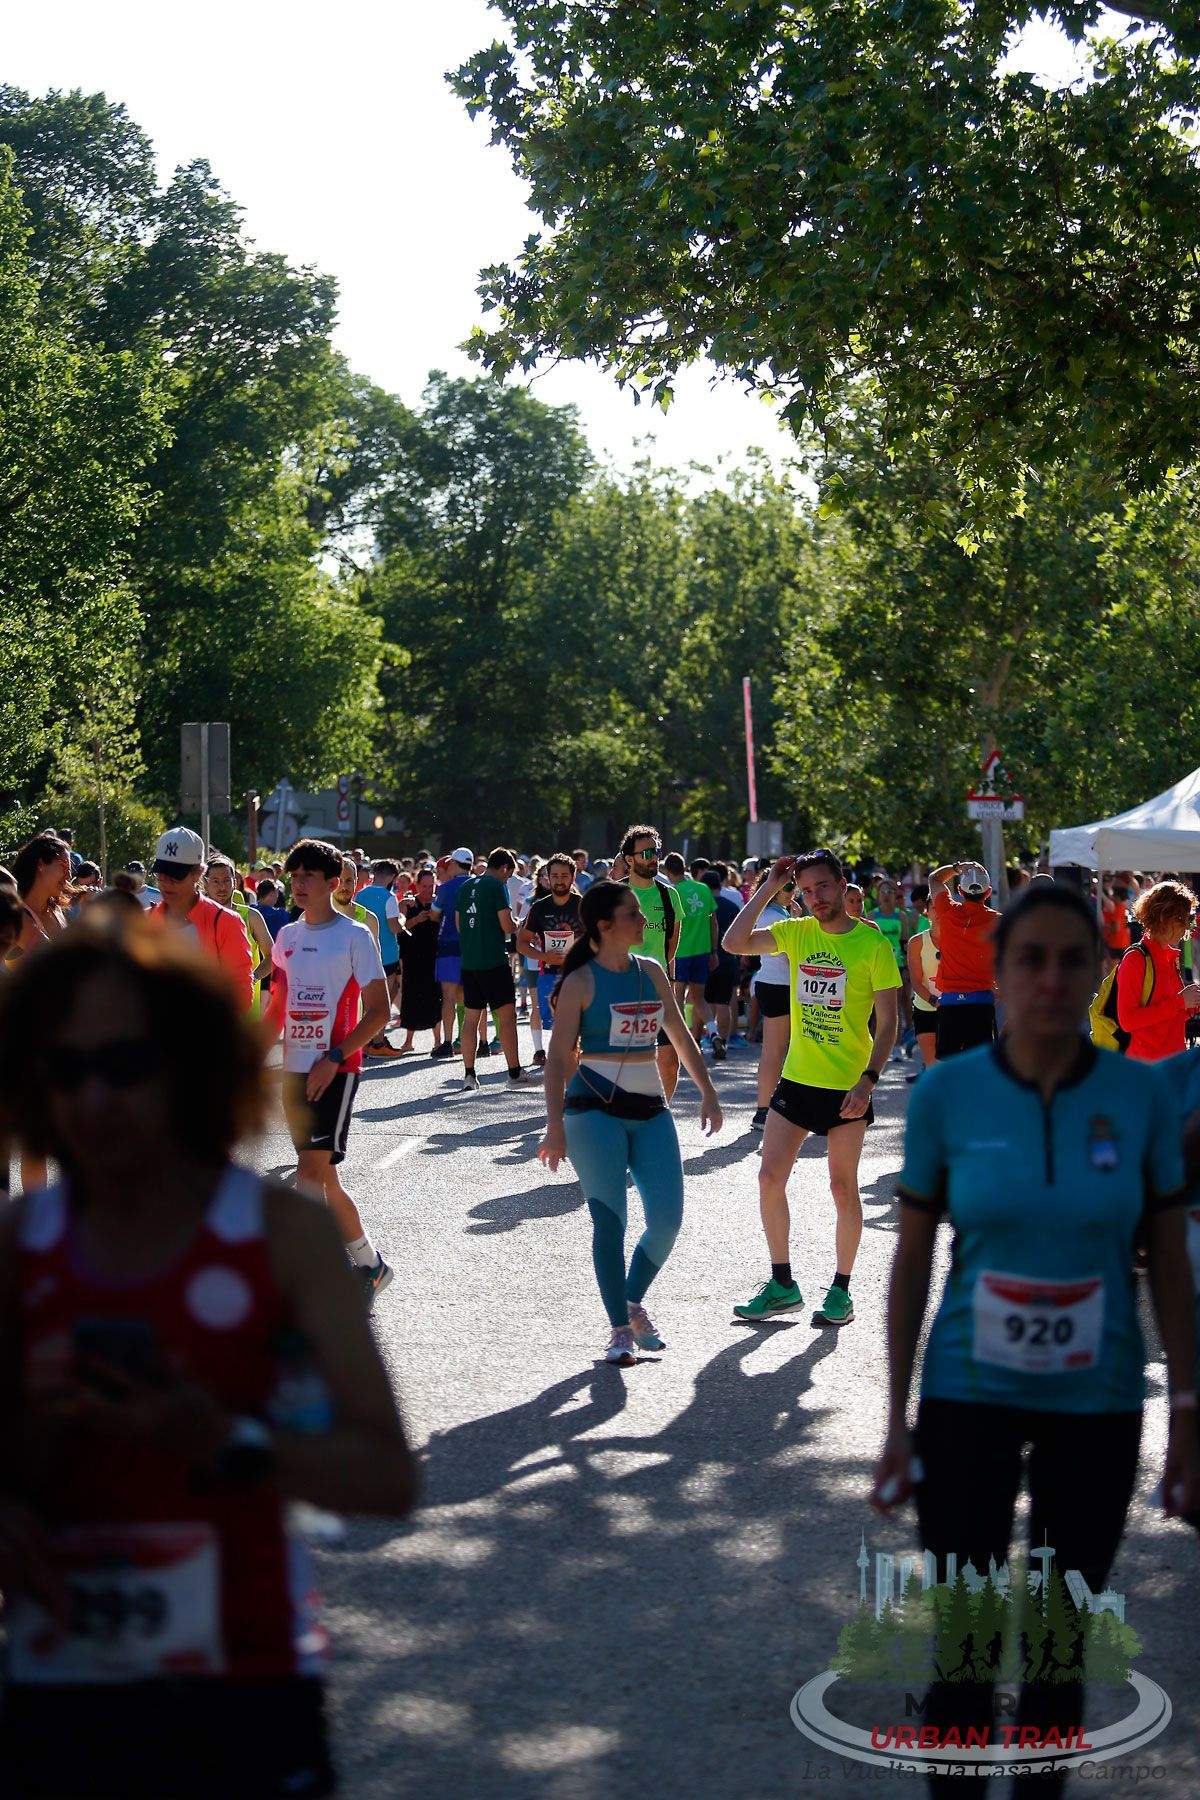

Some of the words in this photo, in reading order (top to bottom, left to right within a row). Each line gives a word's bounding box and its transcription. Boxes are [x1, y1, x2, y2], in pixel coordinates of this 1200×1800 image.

[164, 841, 179, 857] NY
[551, 939, 567, 948] 377
[803, 979, 838, 996] 1074
[291, 1025, 324, 1039] 2226
[620, 1018, 658, 1034] 2126
[1004, 1314, 1074, 1345] 920
